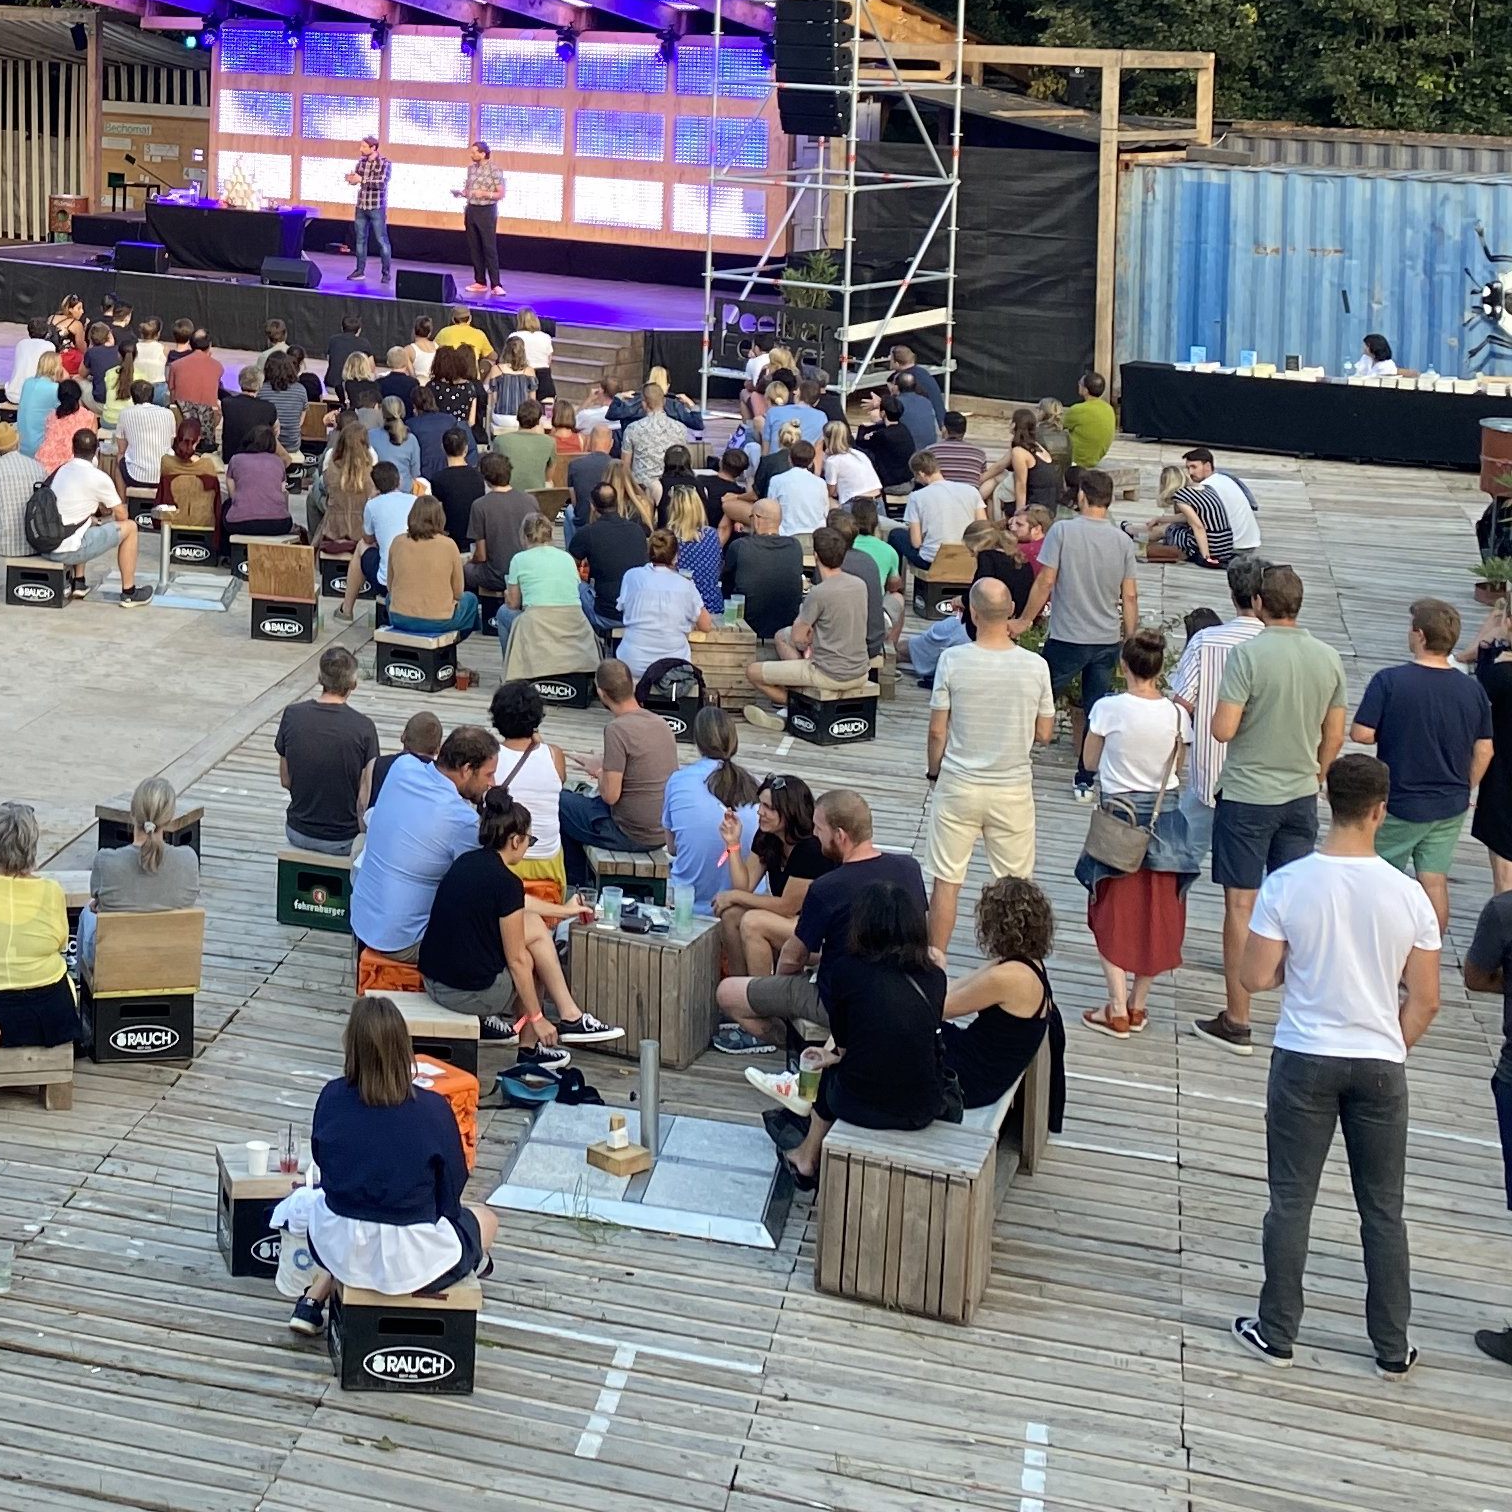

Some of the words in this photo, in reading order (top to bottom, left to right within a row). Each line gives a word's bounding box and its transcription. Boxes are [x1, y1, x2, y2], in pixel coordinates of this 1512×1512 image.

[542, 684, 571, 696] RAUCH
[128, 1031, 171, 1047] RAUCH
[387, 1355, 445, 1374] RAUCH
